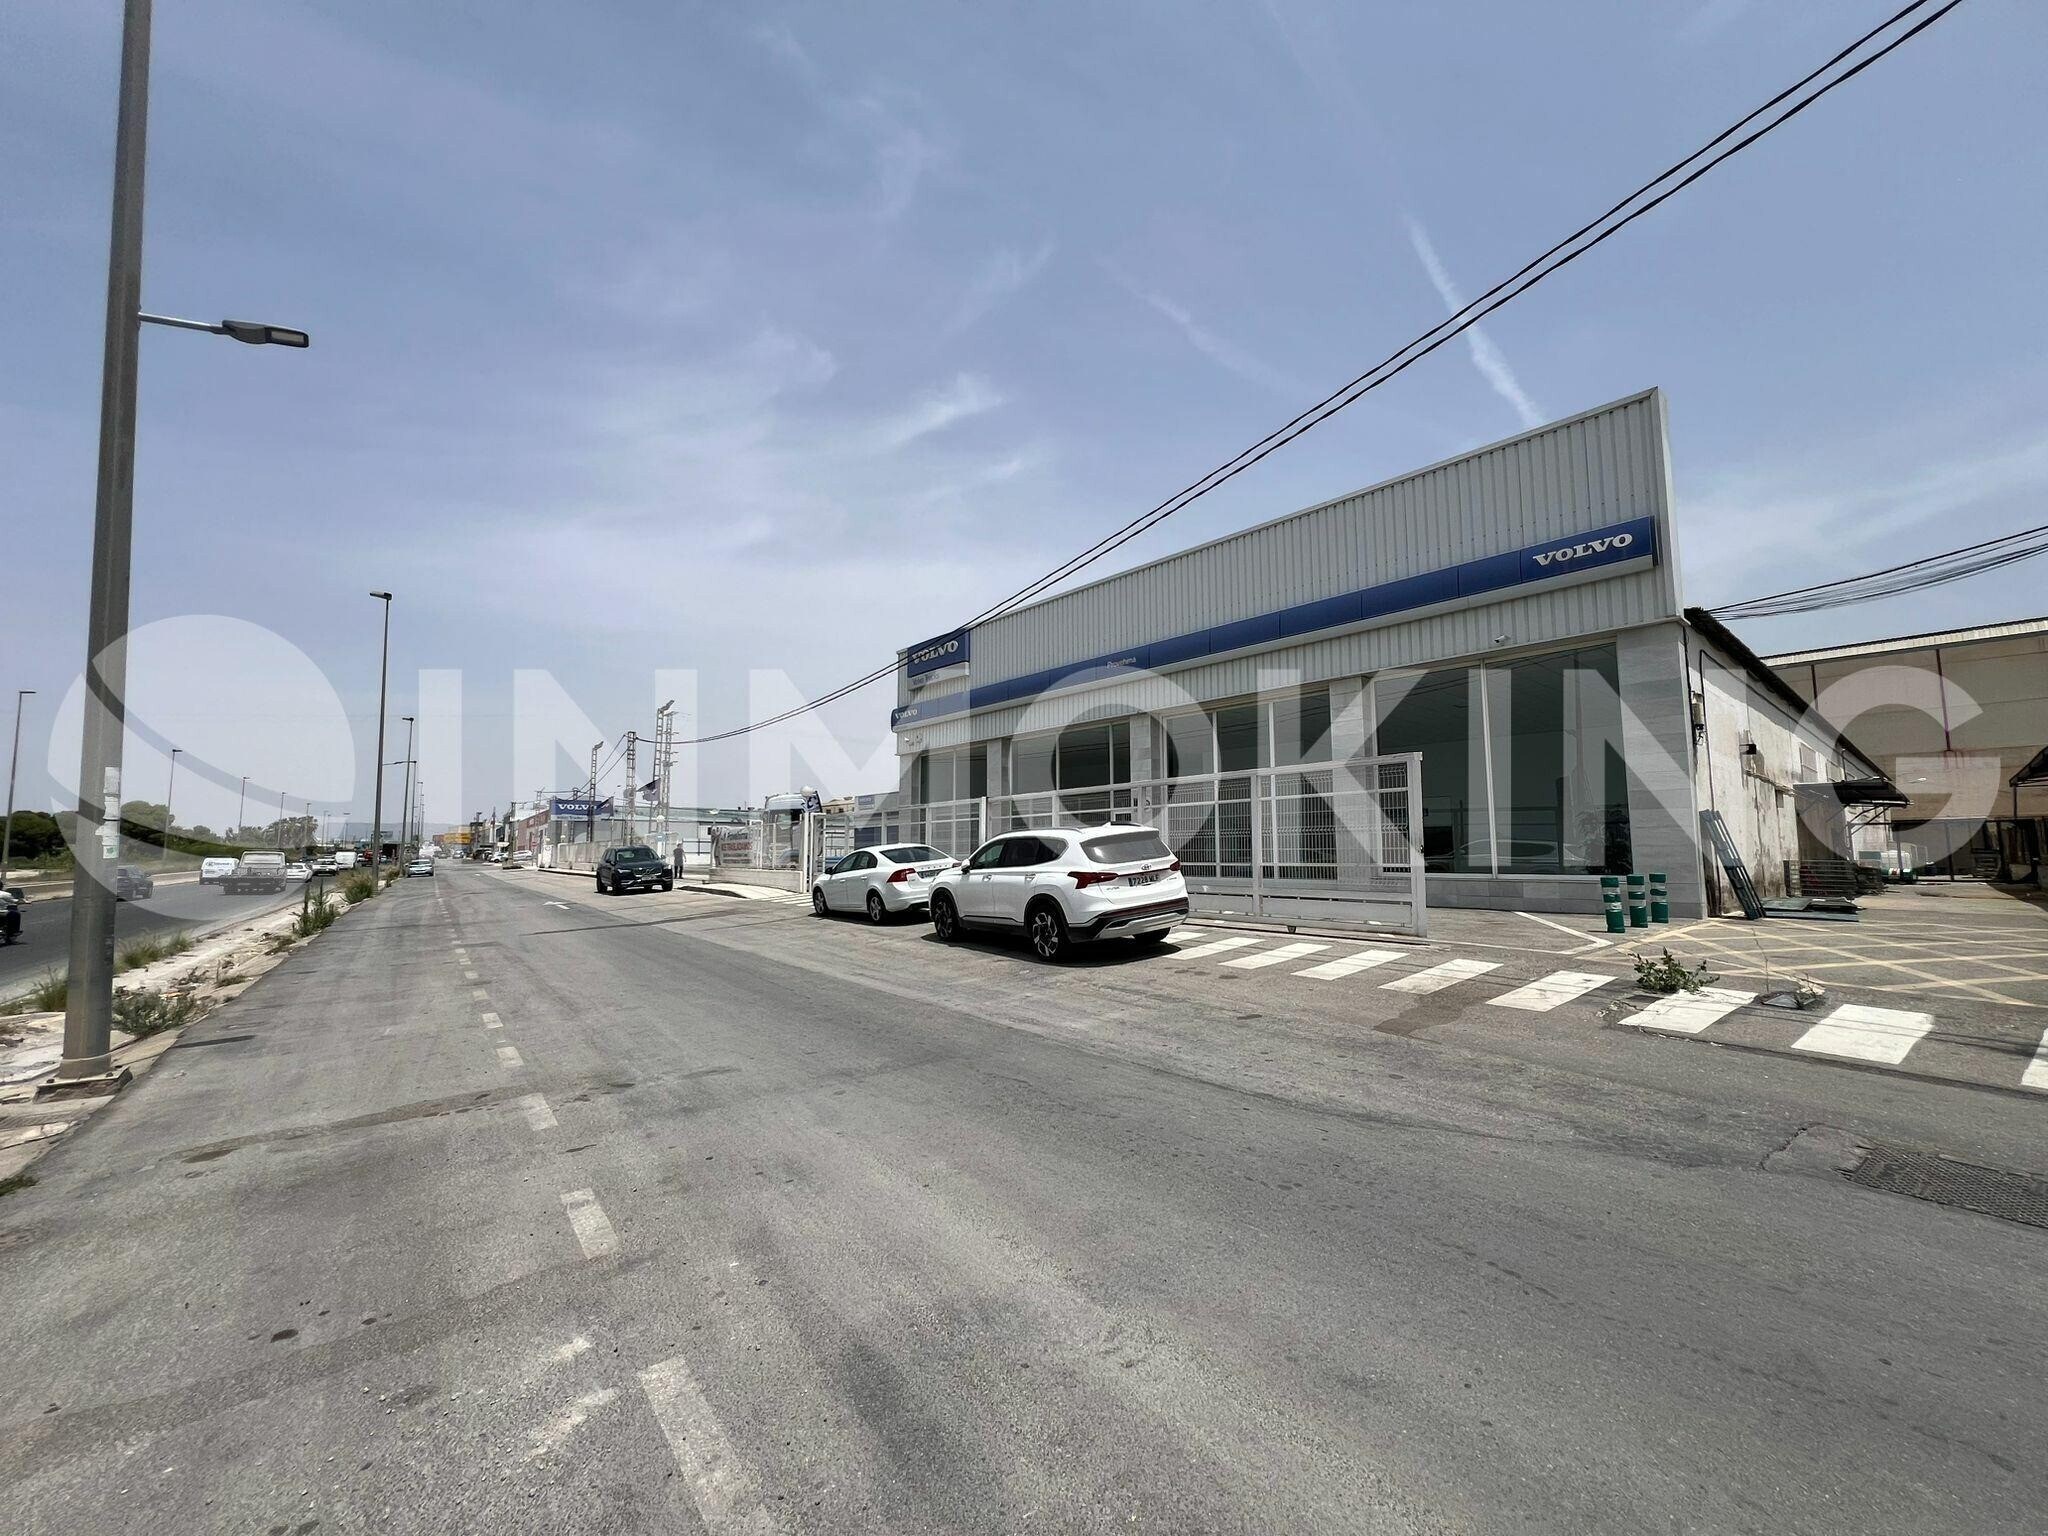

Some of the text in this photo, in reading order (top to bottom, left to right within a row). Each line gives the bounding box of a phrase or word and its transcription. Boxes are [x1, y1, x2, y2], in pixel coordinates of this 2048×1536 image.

[1532, 533, 1633, 566] VOLVO
[912, 640, 959, 664] VOLVO
[895, 708, 918, 719] VOLVO
